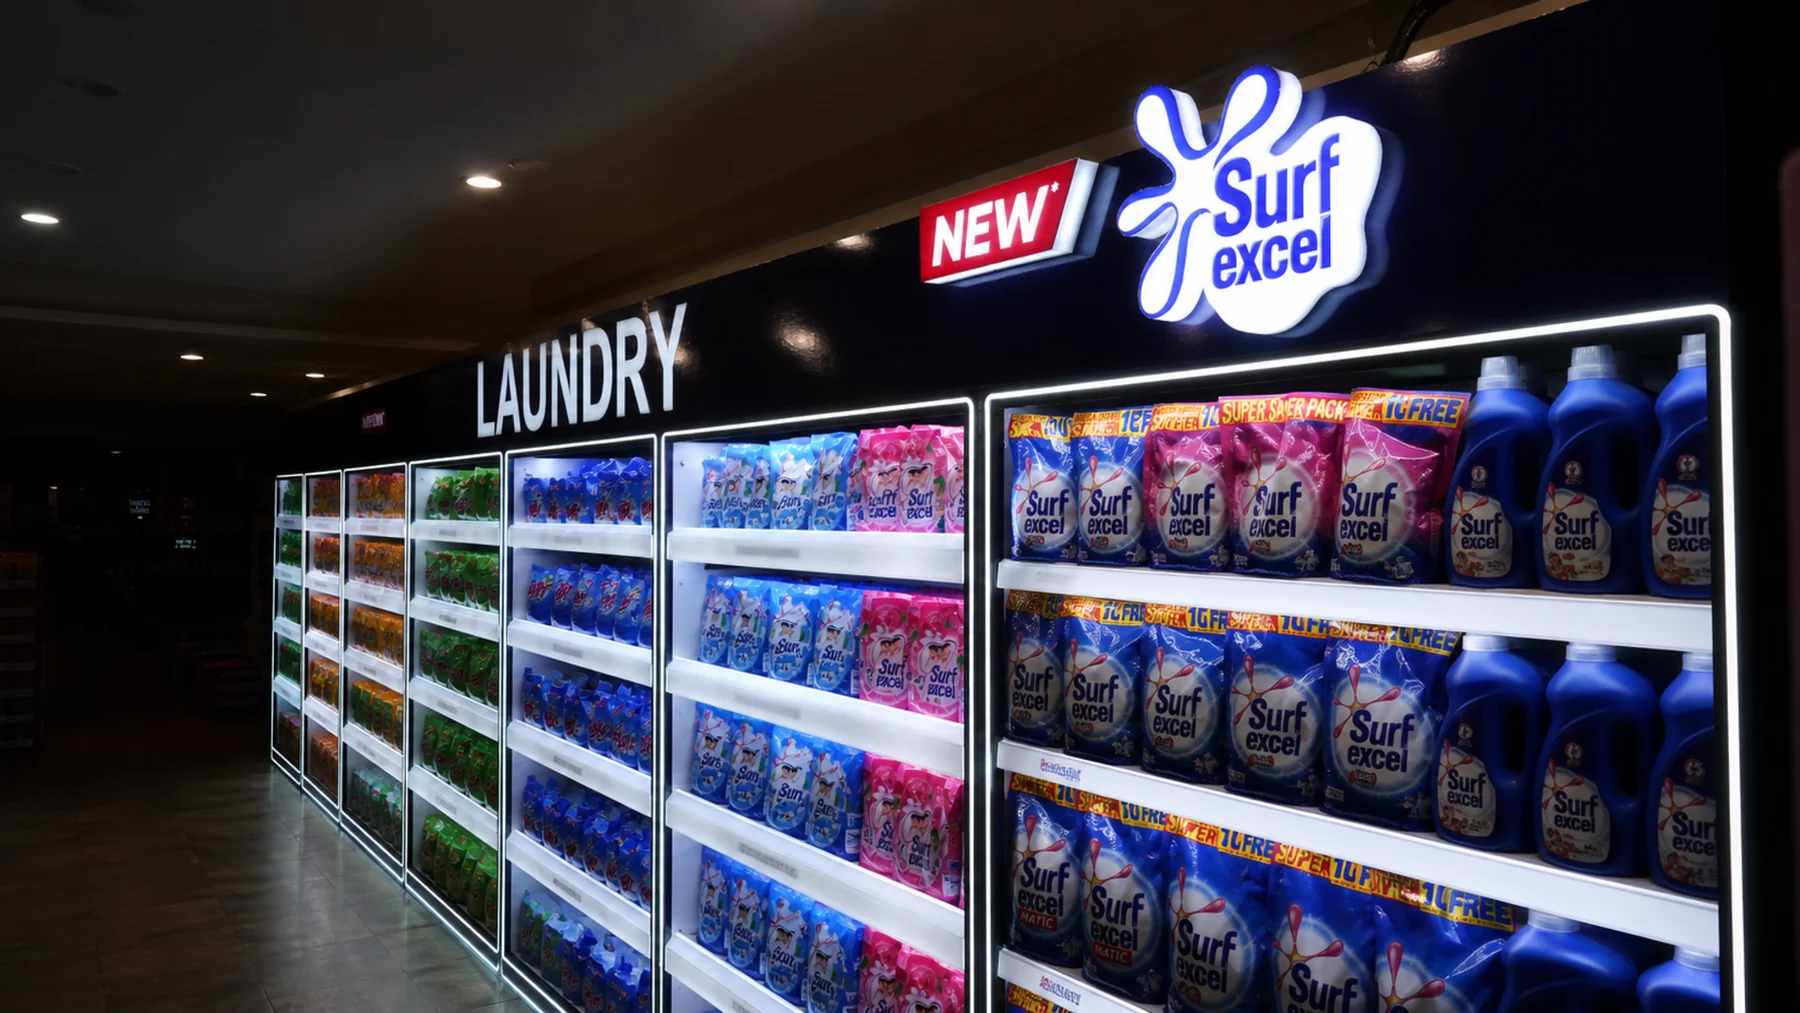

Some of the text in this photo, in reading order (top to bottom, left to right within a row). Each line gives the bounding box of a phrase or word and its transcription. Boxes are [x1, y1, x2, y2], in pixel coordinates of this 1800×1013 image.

[1213, 132, 1340, 238] Surf
[1211, 212, 1332, 289] excel
[477, 302, 688, 438] LAUNDRY
[1222, 400, 1265, 424] SUPER
[1268, 397, 1305, 422] SAER
[1305, 398, 1348, 421] PACK
[1408, 397, 1461, 424] FREE
[1026, 488, 1069, 516] Surf
[1089, 486, 1132, 517] Surf
[1170, 484, 1215, 516] Surf
[1252, 482, 1302, 517] Surf
[1341, 482, 1398, 518] Surf
[1024, 516, 1064, 535] excel
[1088, 516, 1128, 535] excel
[1169, 516, 1210, 536] excel
[1250, 516, 1296, 538] excel
[1340, 517, 1388, 542] excel
[1461, 512, 1502, 535] Surf
[1554, 511, 1599, 535] Surf
[1667, 511, 1710, 536] Sur
[1461, 534, 1499, 550] excel
[1554, 534, 1597, 550] excel
[1667, 537, 1711, 552] exce
[930, 665, 958, 683] Surf
[1014, 664, 1054, 693] Surf
[1012, 692, 1048, 711] excel
[1072, 673, 1119, 703] Surf
[1155, 684, 1203, 718] Surf
[1072, 702, 1114, 723] excel
[1248, 697, 1307, 734] Surf
[1153, 715, 1196, 739] excel
[1350, 709, 1414, 747] Surf
[1246, 732, 1300, 756] excel
[1347, 745, 1408, 772] excel
[1447, 769, 1486, 794] Surf
[1447, 790, 1483, 809] excel
[1554, 791, 1598, 817] Surf
[1554, 813, 1595, 833] excel
[1672, 811, 1715, 840] Sur
[1672, 837, 1715, 857] exce
[1020, 856, 1070, 893] Surf
[1018, 888, 1064, 917] excel
[1091, 885, 1145, 927] Surf
[1448, 889, 1512, 925] FREE
[1019, 913, 1054, 928] MATIC
[1090, 920, 1139, 950] excel
[1177, 918, 1238, 969] Surf
[1094, 943, 1129, 963] MATIC
[1176, 956, 1227, 993] excel
[1289, 962, 1358, 1013] Surf
